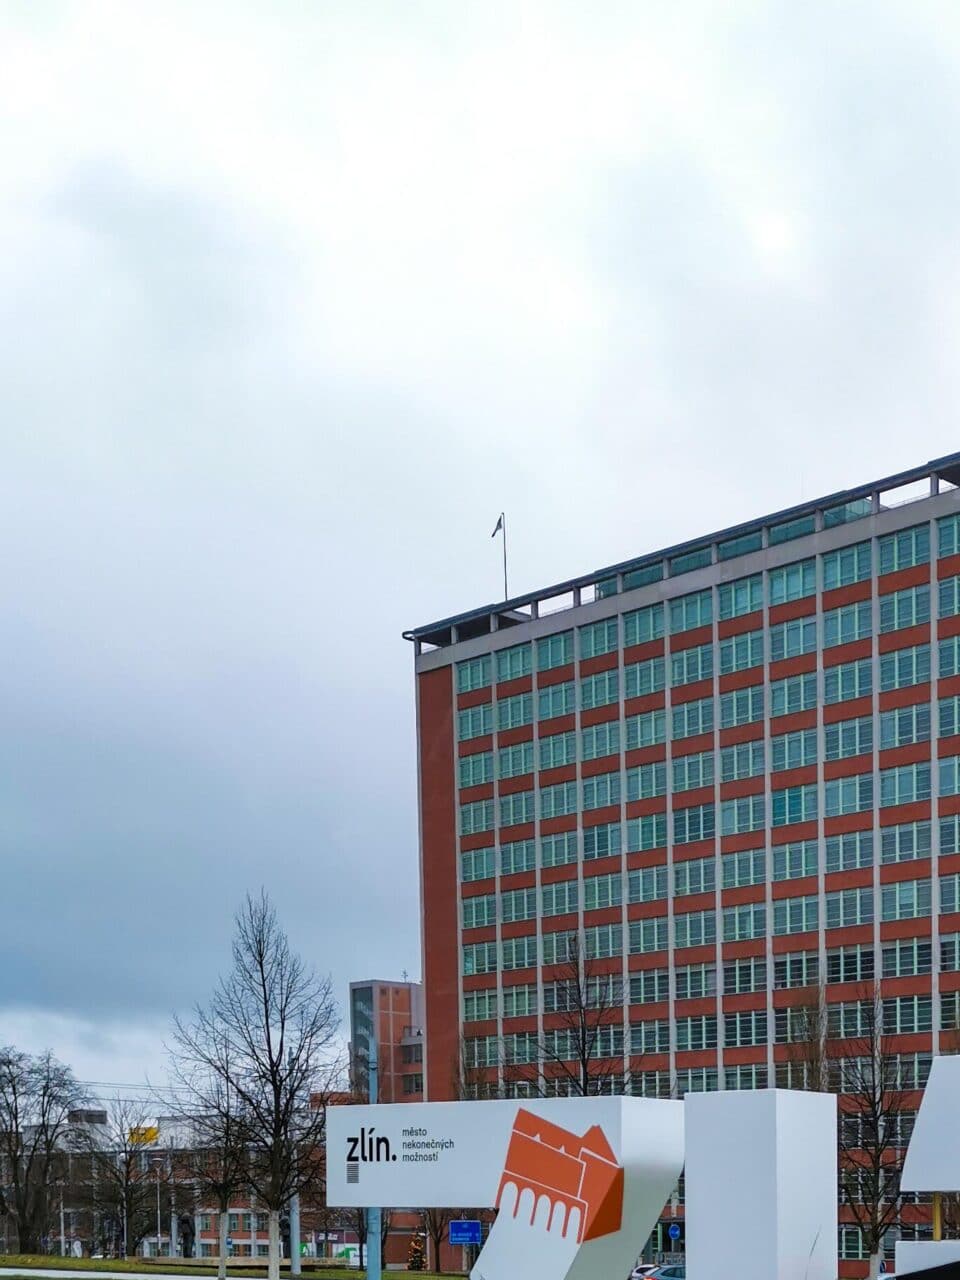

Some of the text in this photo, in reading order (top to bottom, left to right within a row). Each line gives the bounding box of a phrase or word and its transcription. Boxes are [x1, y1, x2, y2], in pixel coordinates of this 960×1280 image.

[402, 1127, 428, 1137] město
[402, 1139, 455, 1150] nekonečných
[402, 1152, 439, 1162] možností
